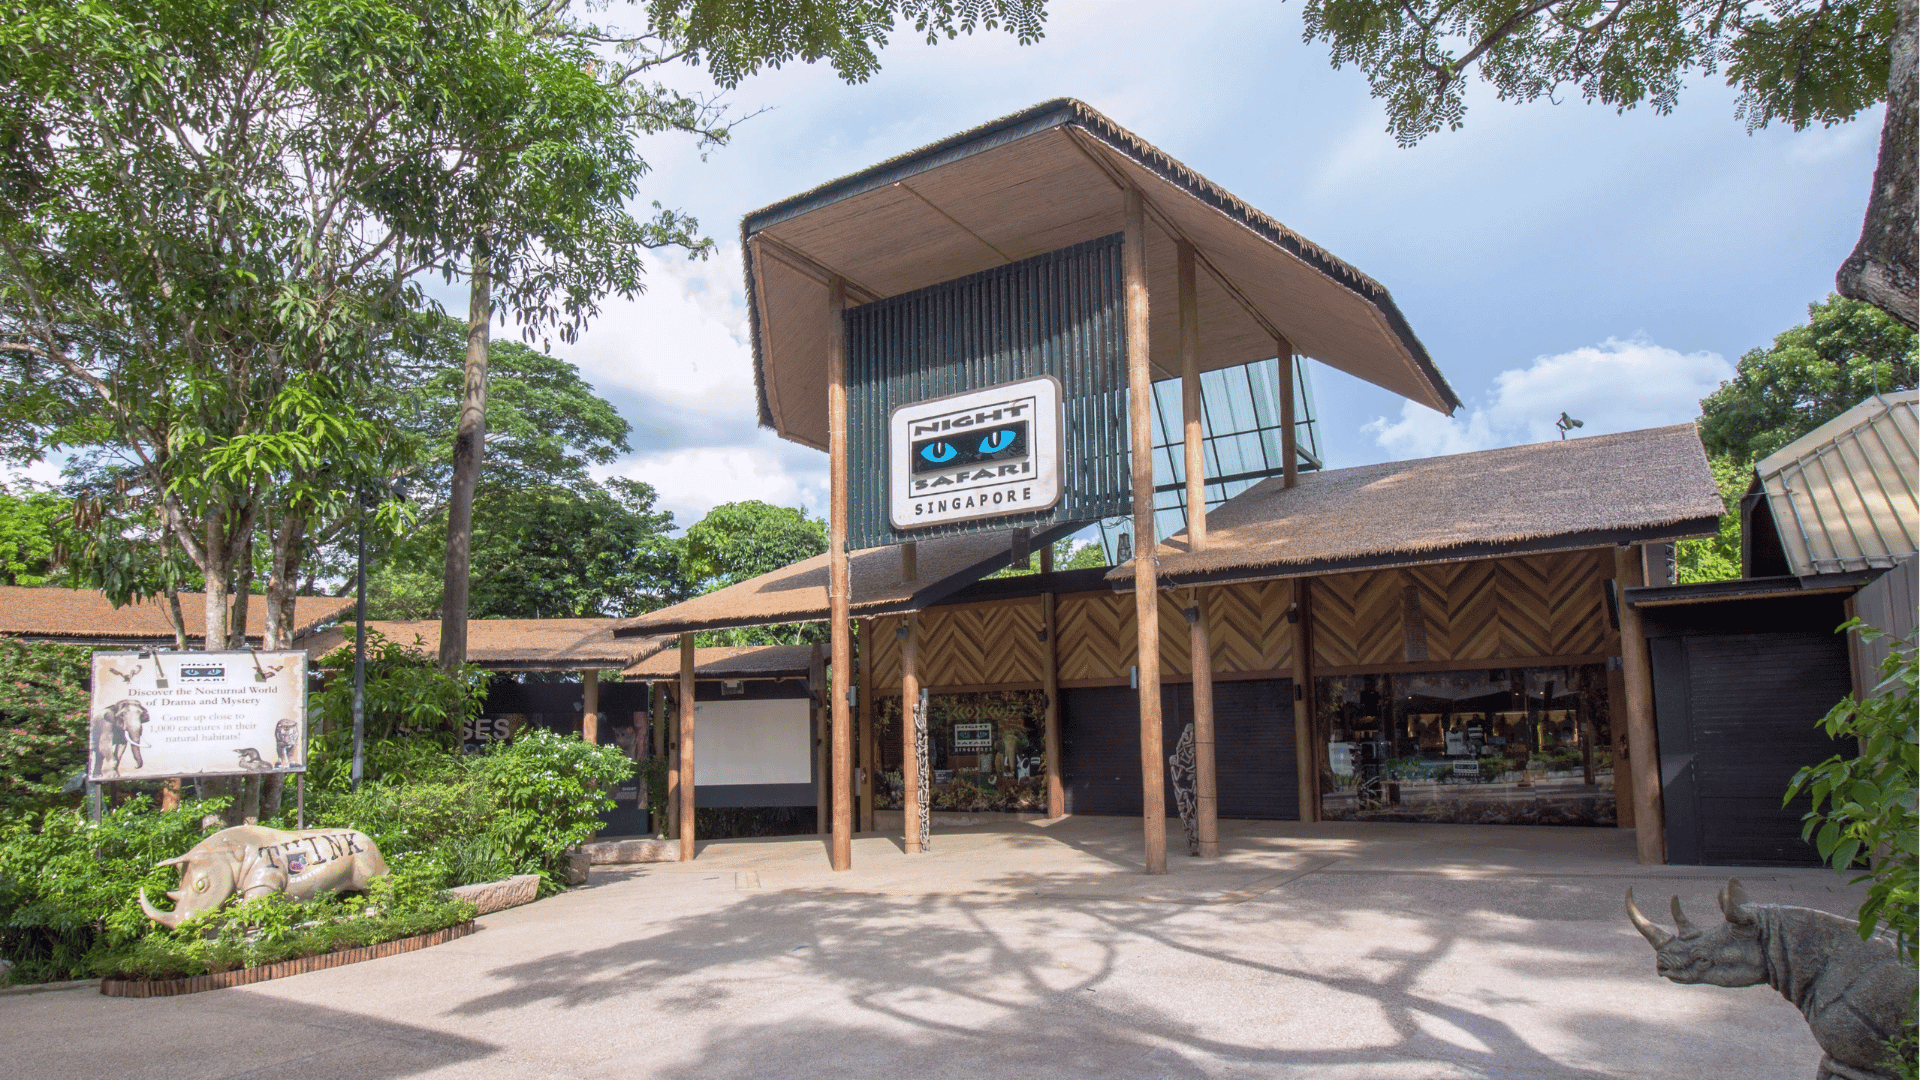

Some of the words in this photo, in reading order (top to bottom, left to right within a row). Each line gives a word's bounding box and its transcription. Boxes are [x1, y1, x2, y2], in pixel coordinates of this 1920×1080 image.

[914, 403, 1029, 437] NIGHT
[914, 461, 1031, 490] SAFARI
[914, 487, 1031, 516] SINGAPORE
[128, 688, 173, 697] Discover
[176, 688, 193, 696] the
[195, 687, 246, 695] Nocturnal
[249, 686, 278, 694] World
[146, 698, 157, 706] of
[161, 698, 196, 706] Drama
[199, 697, 218, 705] and
[221, 697, 261, 707] Mystery
[162, 714, 191, 722] Come
[193, 715, 206, 724] up
[209, 712, 231, 721] close
[178, 724, 220, 732] creatures
[235, 722, 257, 730] their
[165, 734, 198, 743] natural
[201, 732, 242, 742] habitats!
